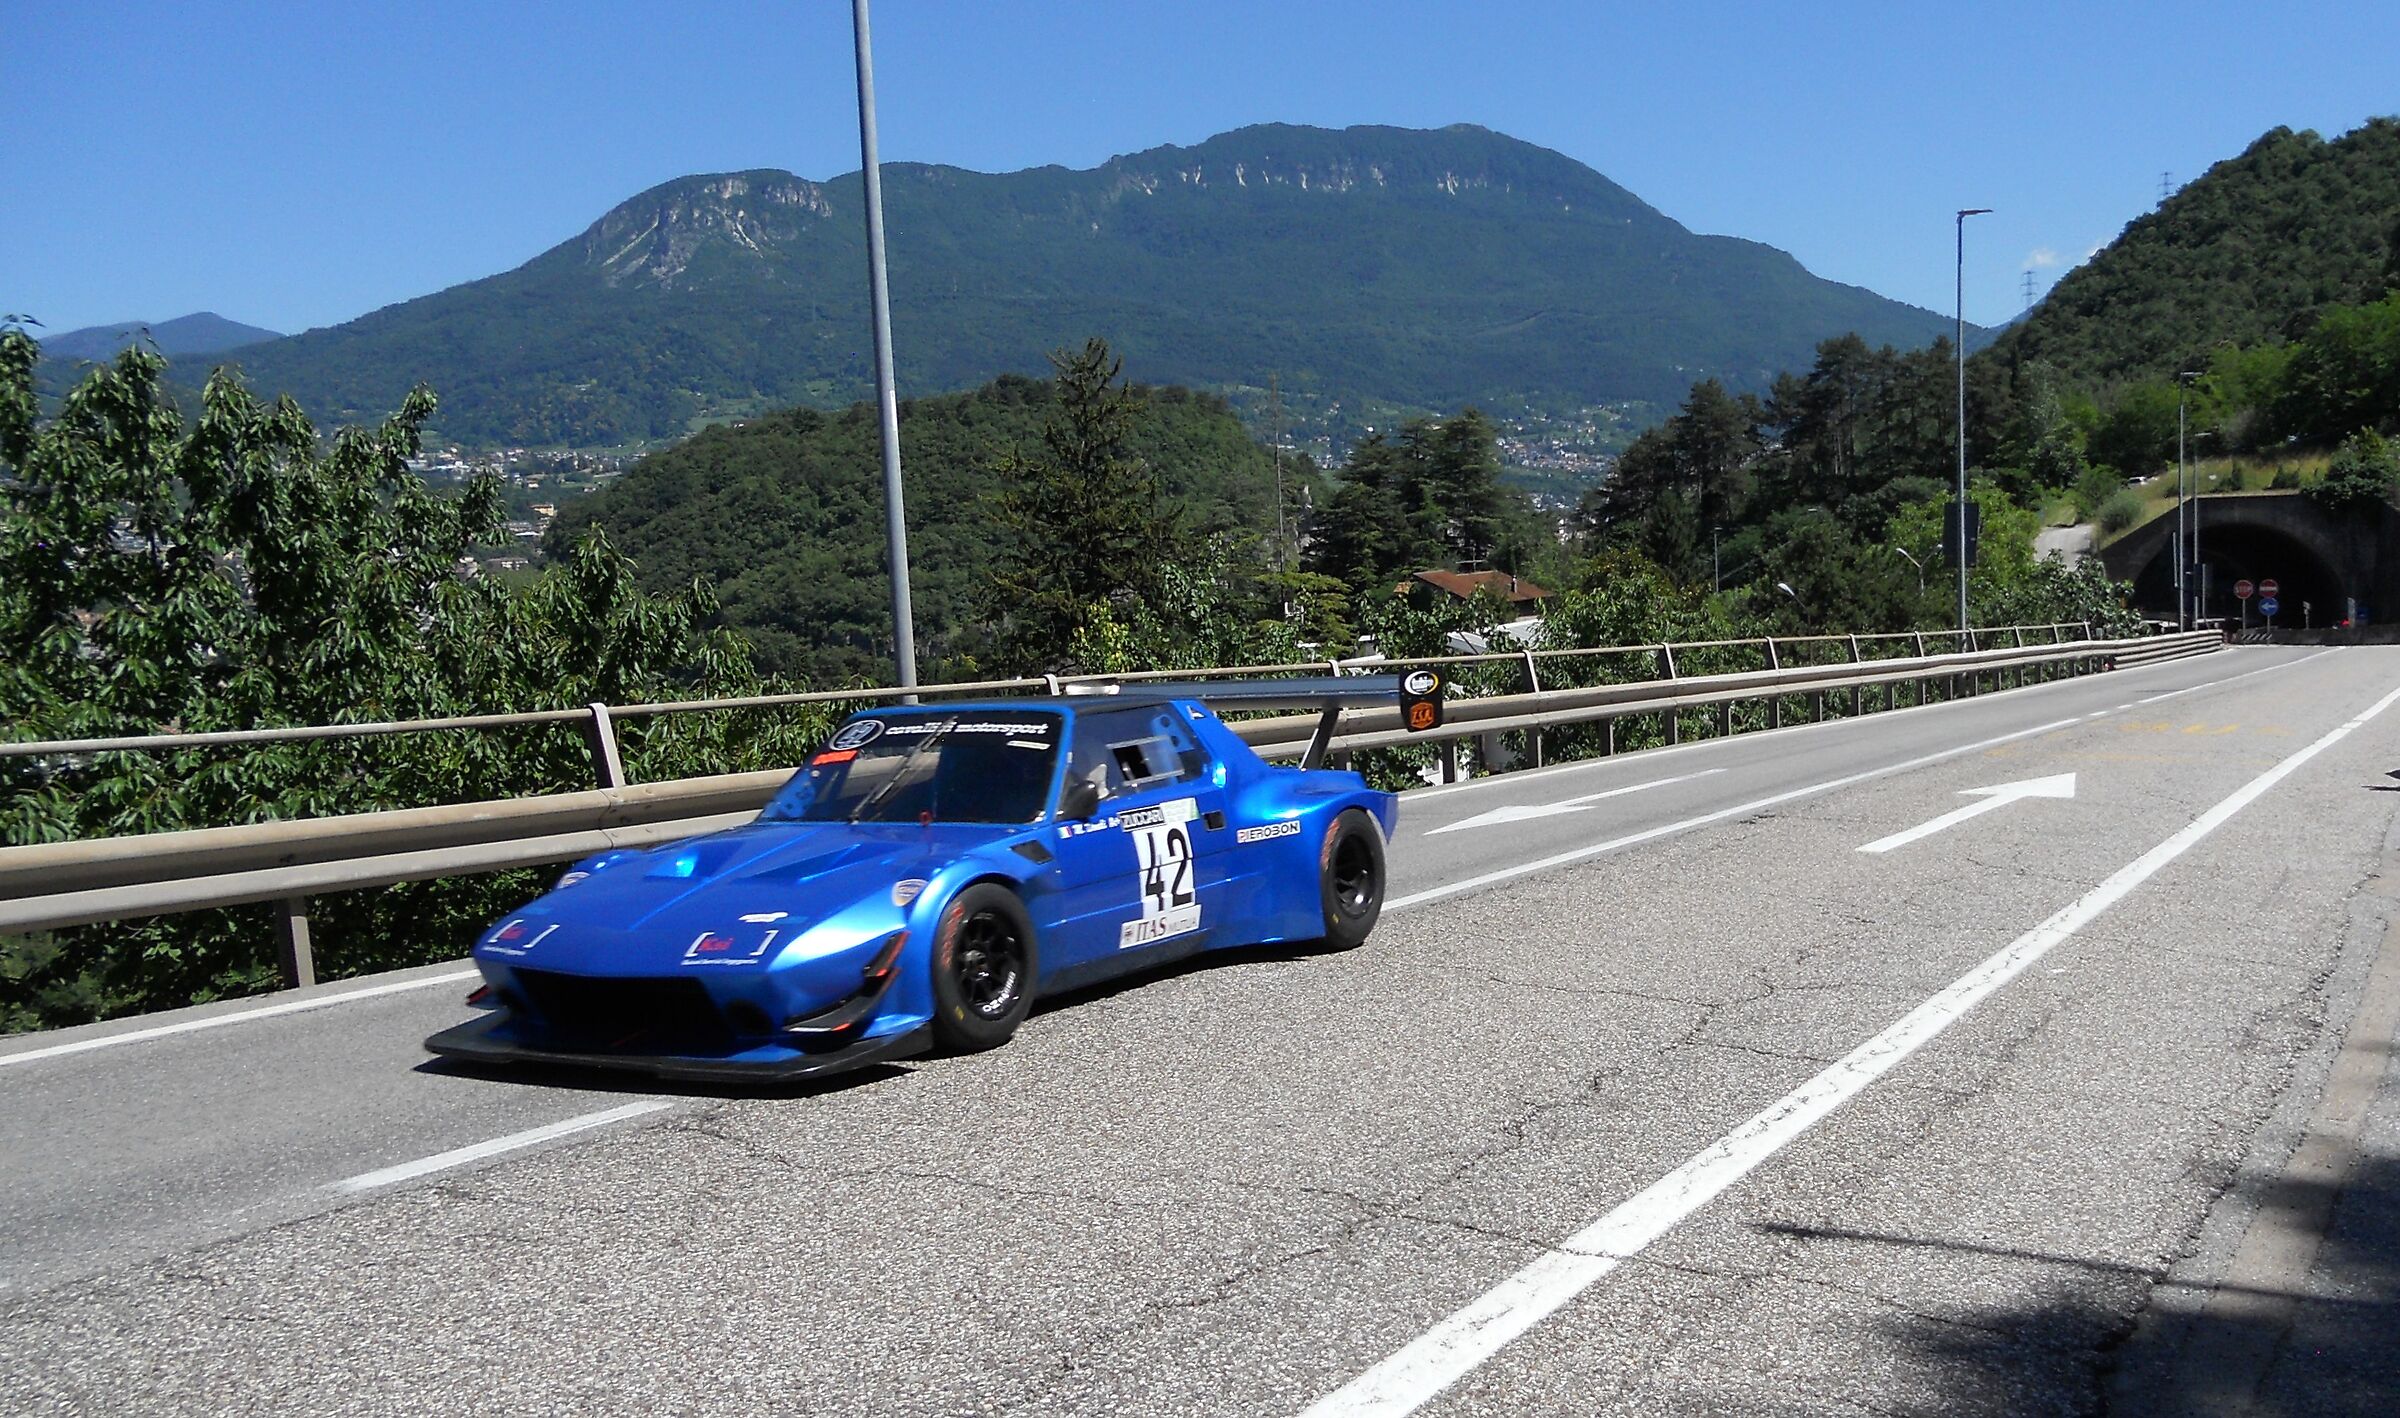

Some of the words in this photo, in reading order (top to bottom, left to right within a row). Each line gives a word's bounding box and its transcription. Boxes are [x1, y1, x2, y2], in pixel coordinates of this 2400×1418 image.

[1239, 822, 1298, 841] PIEROBON
[1145, 828, 1192, 912] 42
[1136, 917, 1167, 942] ITAS
